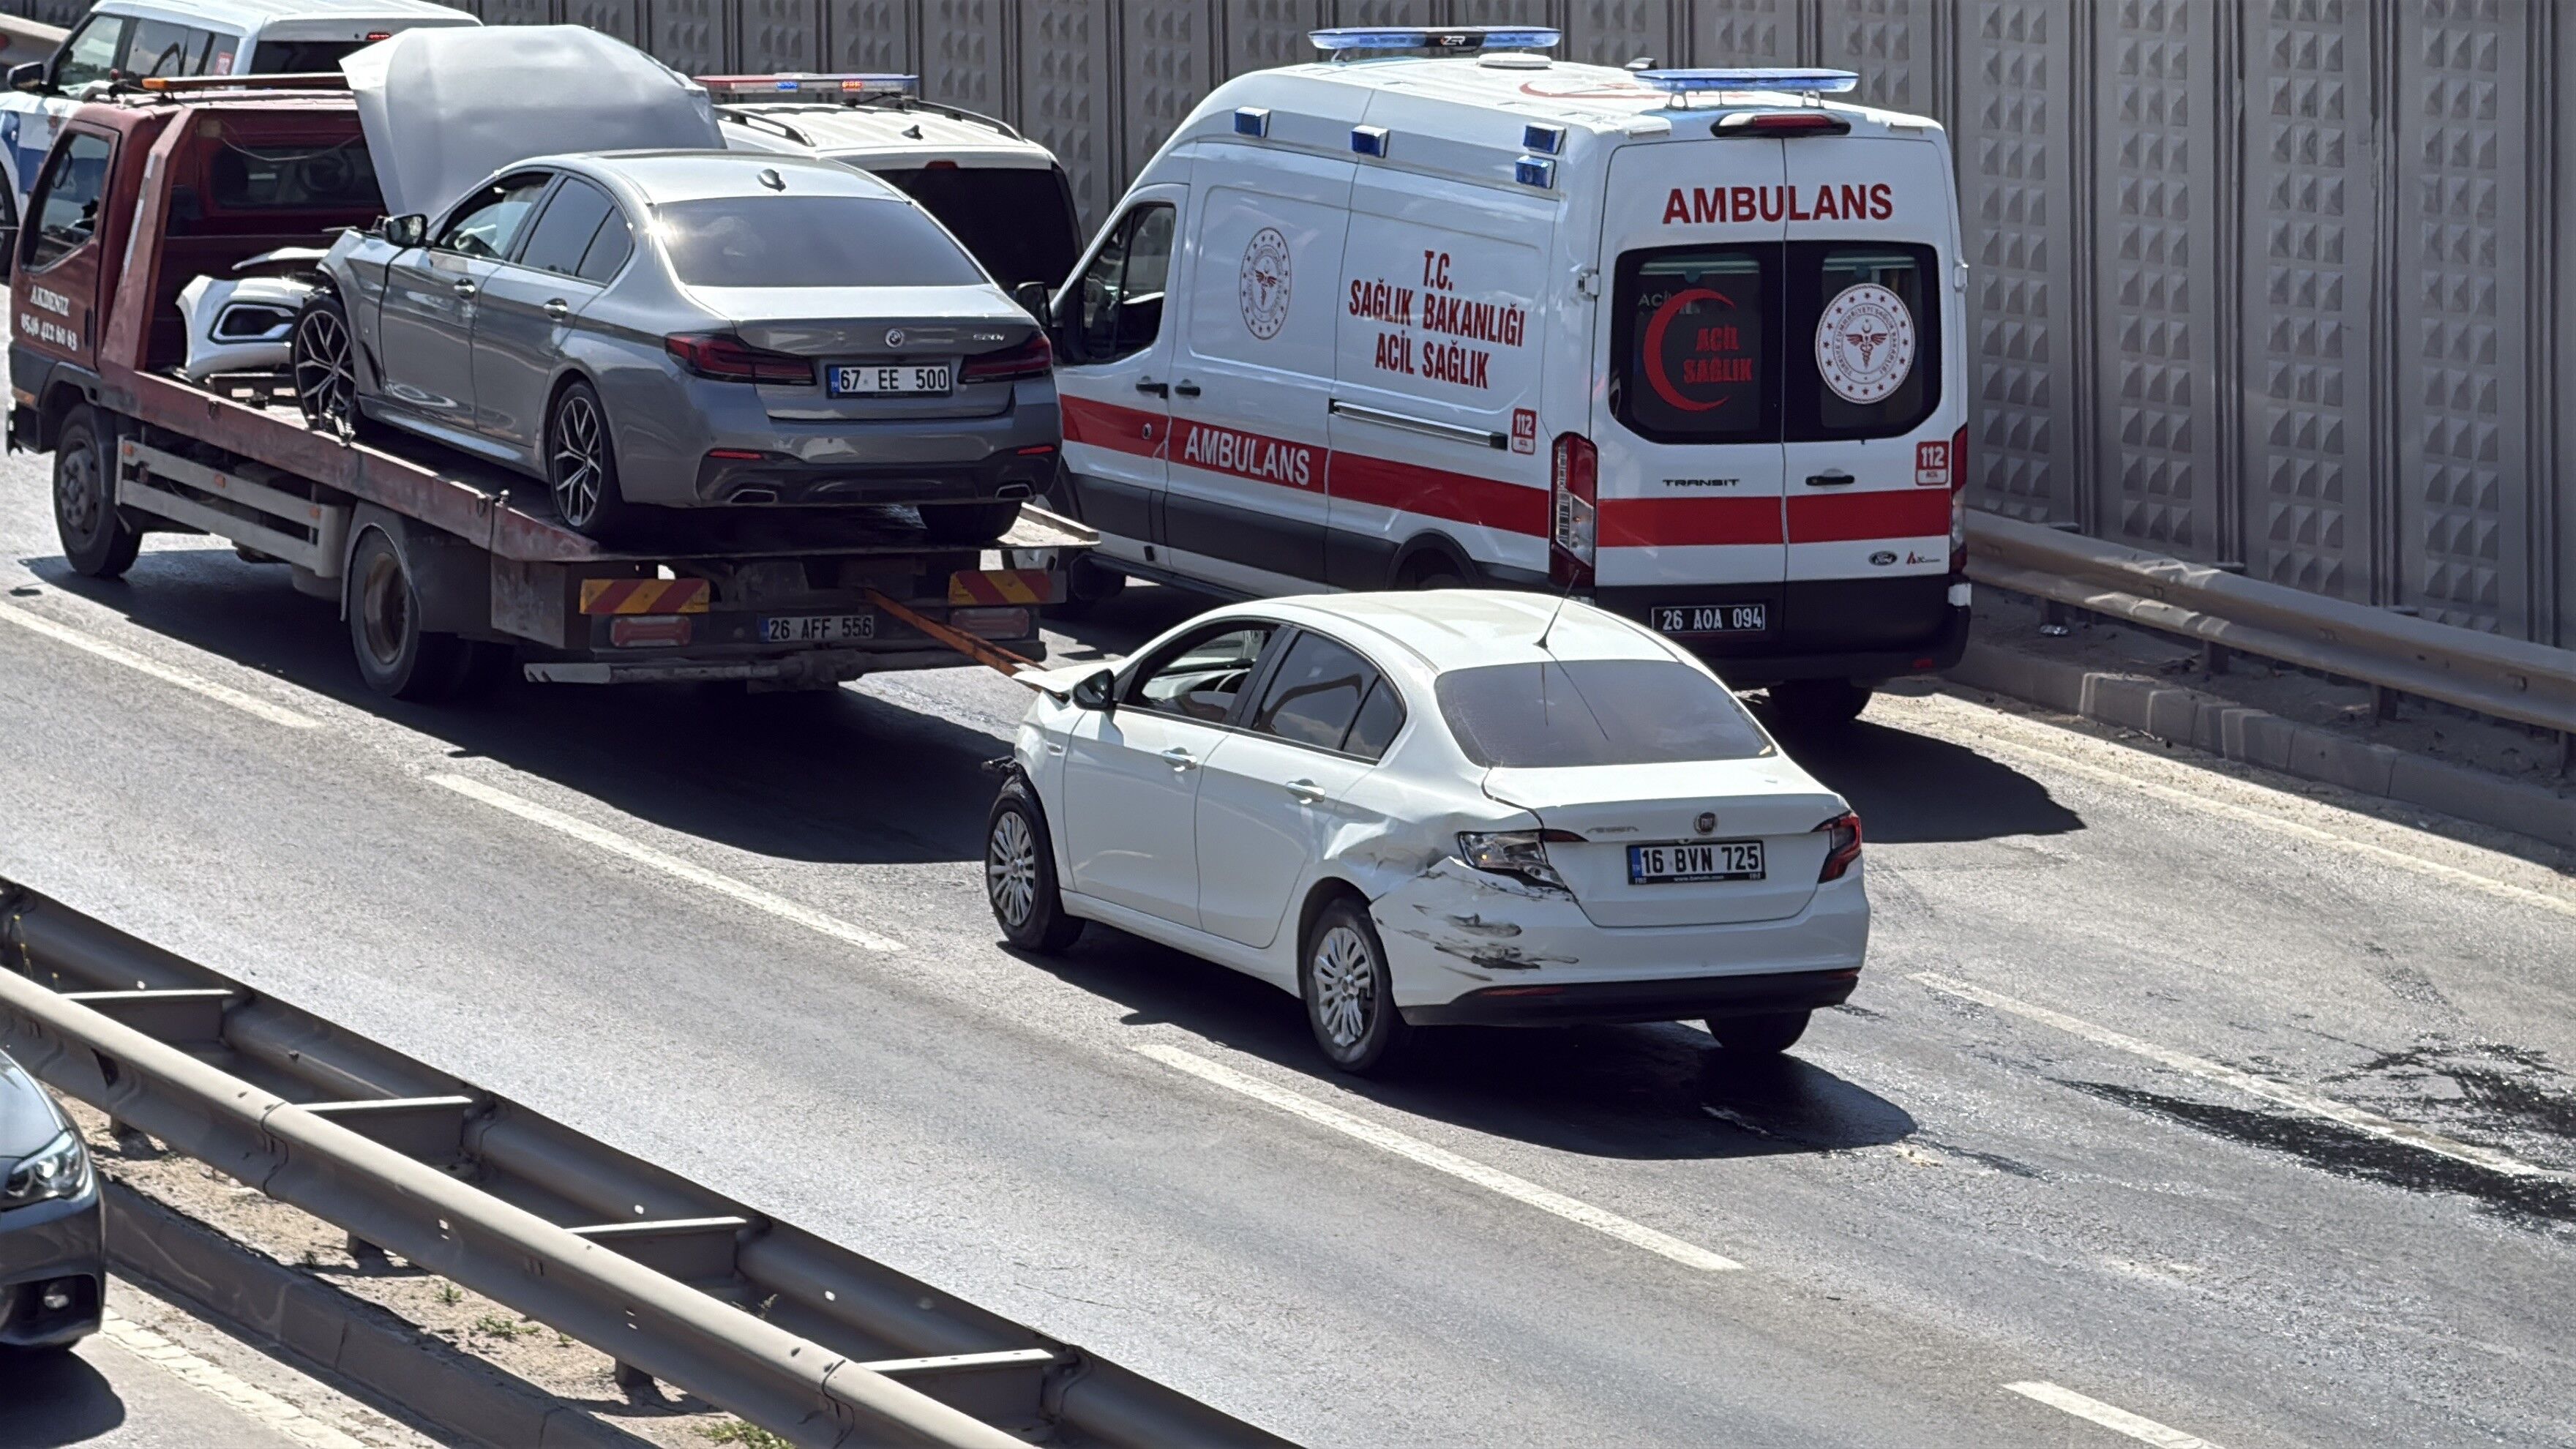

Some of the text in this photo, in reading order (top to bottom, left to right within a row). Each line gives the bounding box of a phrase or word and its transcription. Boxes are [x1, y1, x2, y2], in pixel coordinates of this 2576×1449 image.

[1662, 183, 1893, 225] AMBULANS
[1423, 250, 1453, 291] T.C.
[1349, 277, 1525, 348] SAĞLIK BAKANLIĞI
[1696, 324, 1740, 351] ACİL
[1374, 329, 1490, 389] ACİL SAĞLIK
[1684, 356, 1753, 383] SAĞLIK
[841, 369, 947, 390] 67 EE 500
[1516, 413, 1532, 435] 112
[1184, 426, 1310, 486] AMBULANS
[1921, 446, 1944, 468] 112
[1662, 479, 1740, 487] TRANSIT
[770, 617, 872, 640] 26 AFF 556
[1663, 610, 1683, 631] 26
[1732, 607, 1762, 628] 094
[1642, 846, 1759, 874] 16 BVN 725
